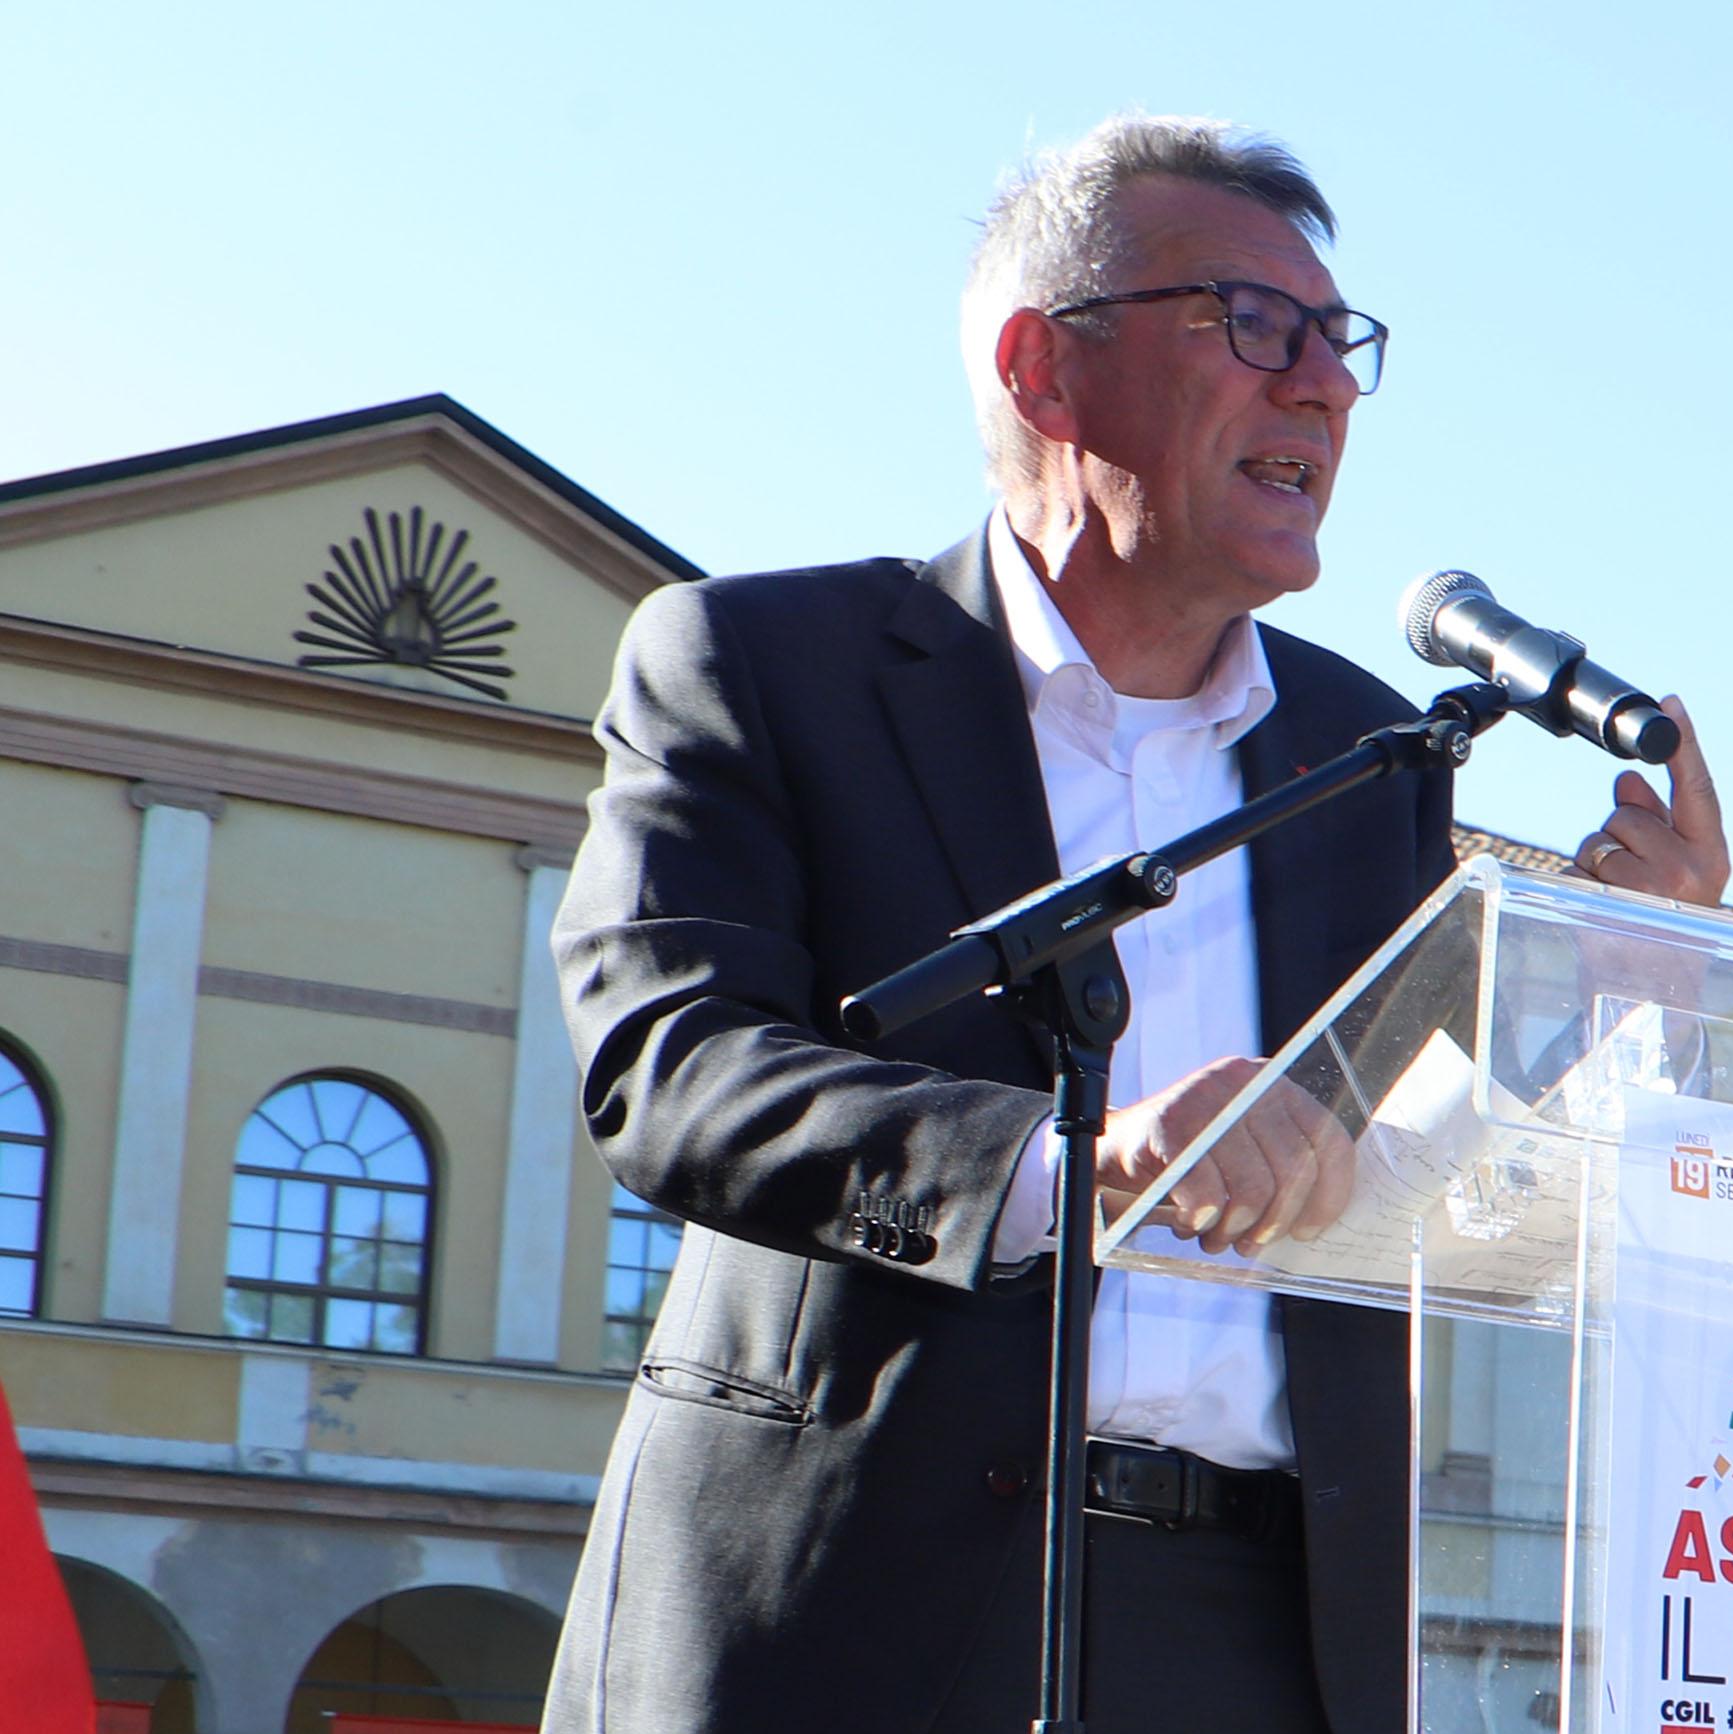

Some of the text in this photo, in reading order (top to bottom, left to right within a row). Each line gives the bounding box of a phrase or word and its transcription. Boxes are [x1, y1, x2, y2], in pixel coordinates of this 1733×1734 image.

[1677, 1156, 1706, 1190] 19
[1661, 1594, 1726, 1685] IL
[1660, 1699, 1715, 1724] CGIL
